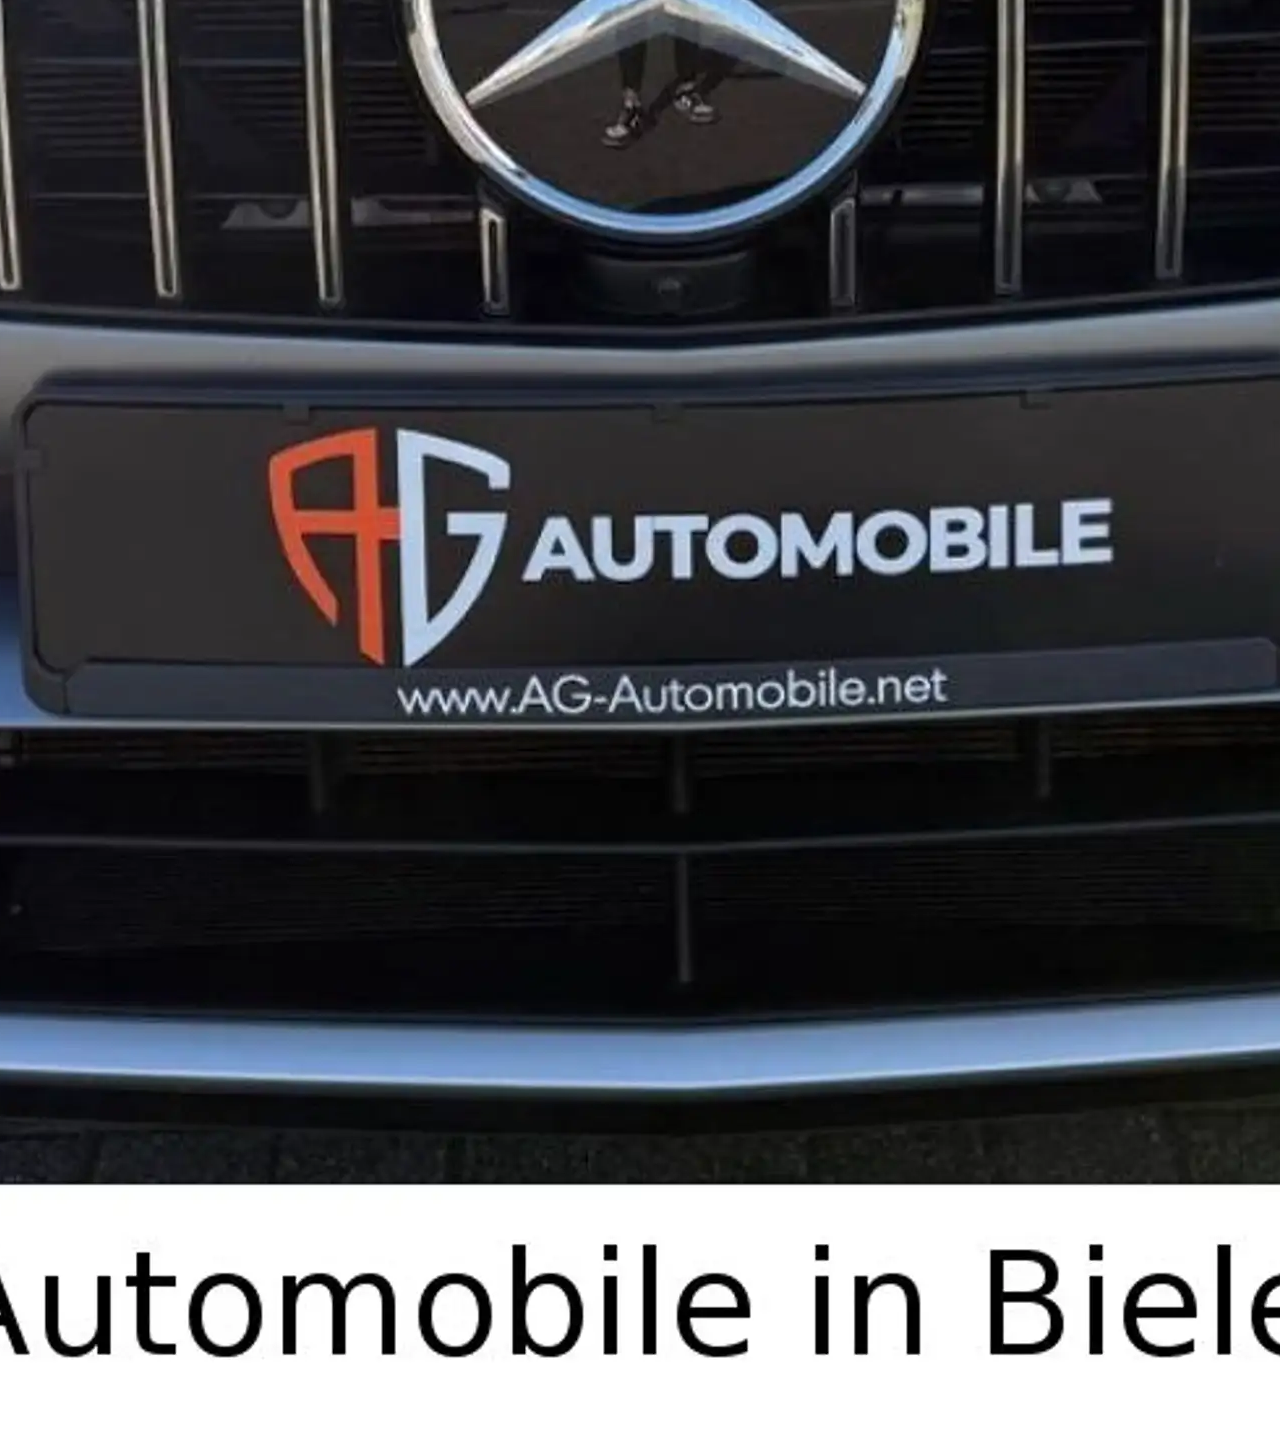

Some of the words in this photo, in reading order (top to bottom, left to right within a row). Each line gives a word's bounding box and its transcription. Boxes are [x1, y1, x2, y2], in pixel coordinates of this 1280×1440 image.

[268, 428, 511, 667] AG
[522, 498, 1113, 582] AUTOMOBILE
[397, 667, 947, 715] www.AG-Automobile.net
